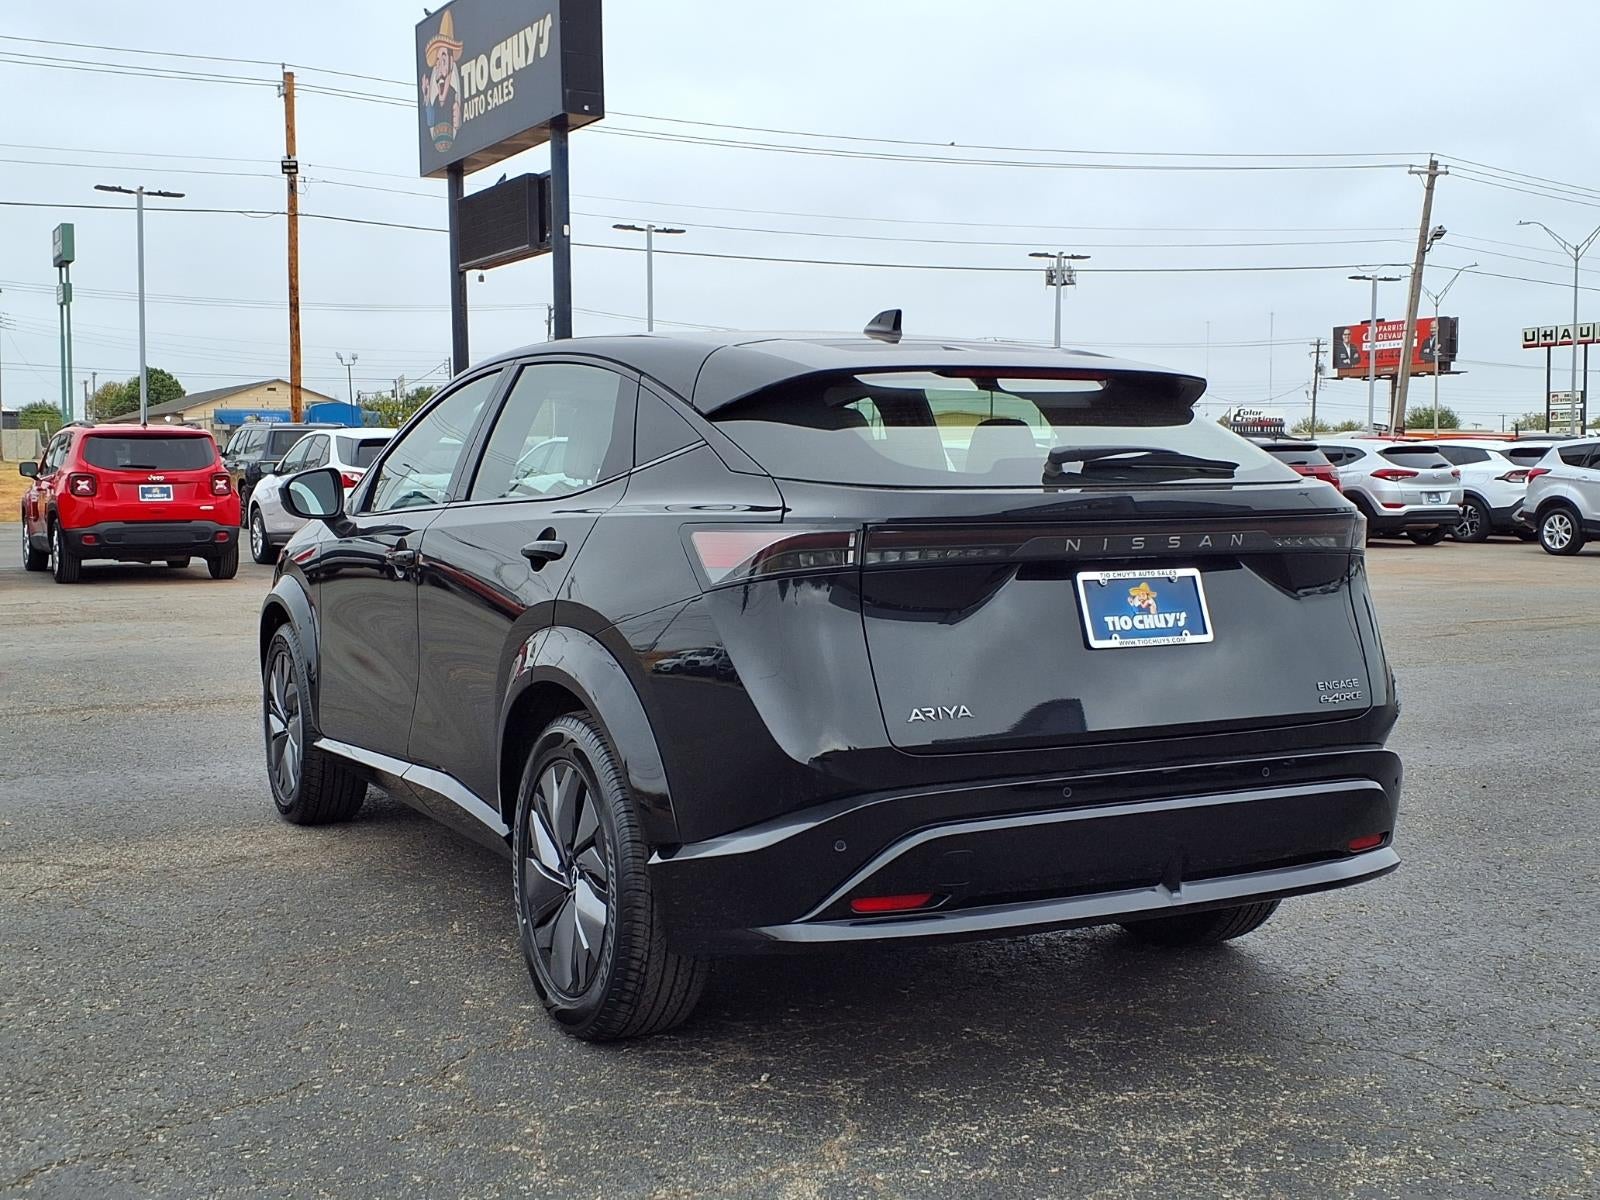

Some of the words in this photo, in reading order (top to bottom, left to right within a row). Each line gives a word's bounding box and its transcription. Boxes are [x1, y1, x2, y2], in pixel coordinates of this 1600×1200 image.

[461, 54, 489, 99] TIO
[489, 13, 552, 83] CHUY'S
[463, 94, 486, 123] AUTO
[487, 78, 514, 111] SALES
[1233, 414, 1284, 422] Creations
[1236, 408, 1263, 416] Color
[1065, 533, 1244, 552] NISSAN
[1103, 615, 1133, 631] TIO
[1132, 611, 1187, 630] CHUY'S
[1119, 637, 1186, 646] WWW.TIOCHUYS.COM
[1317, 678, 1359, 691] ENGAGE
[908, 704, 974, 722] ARIYA
